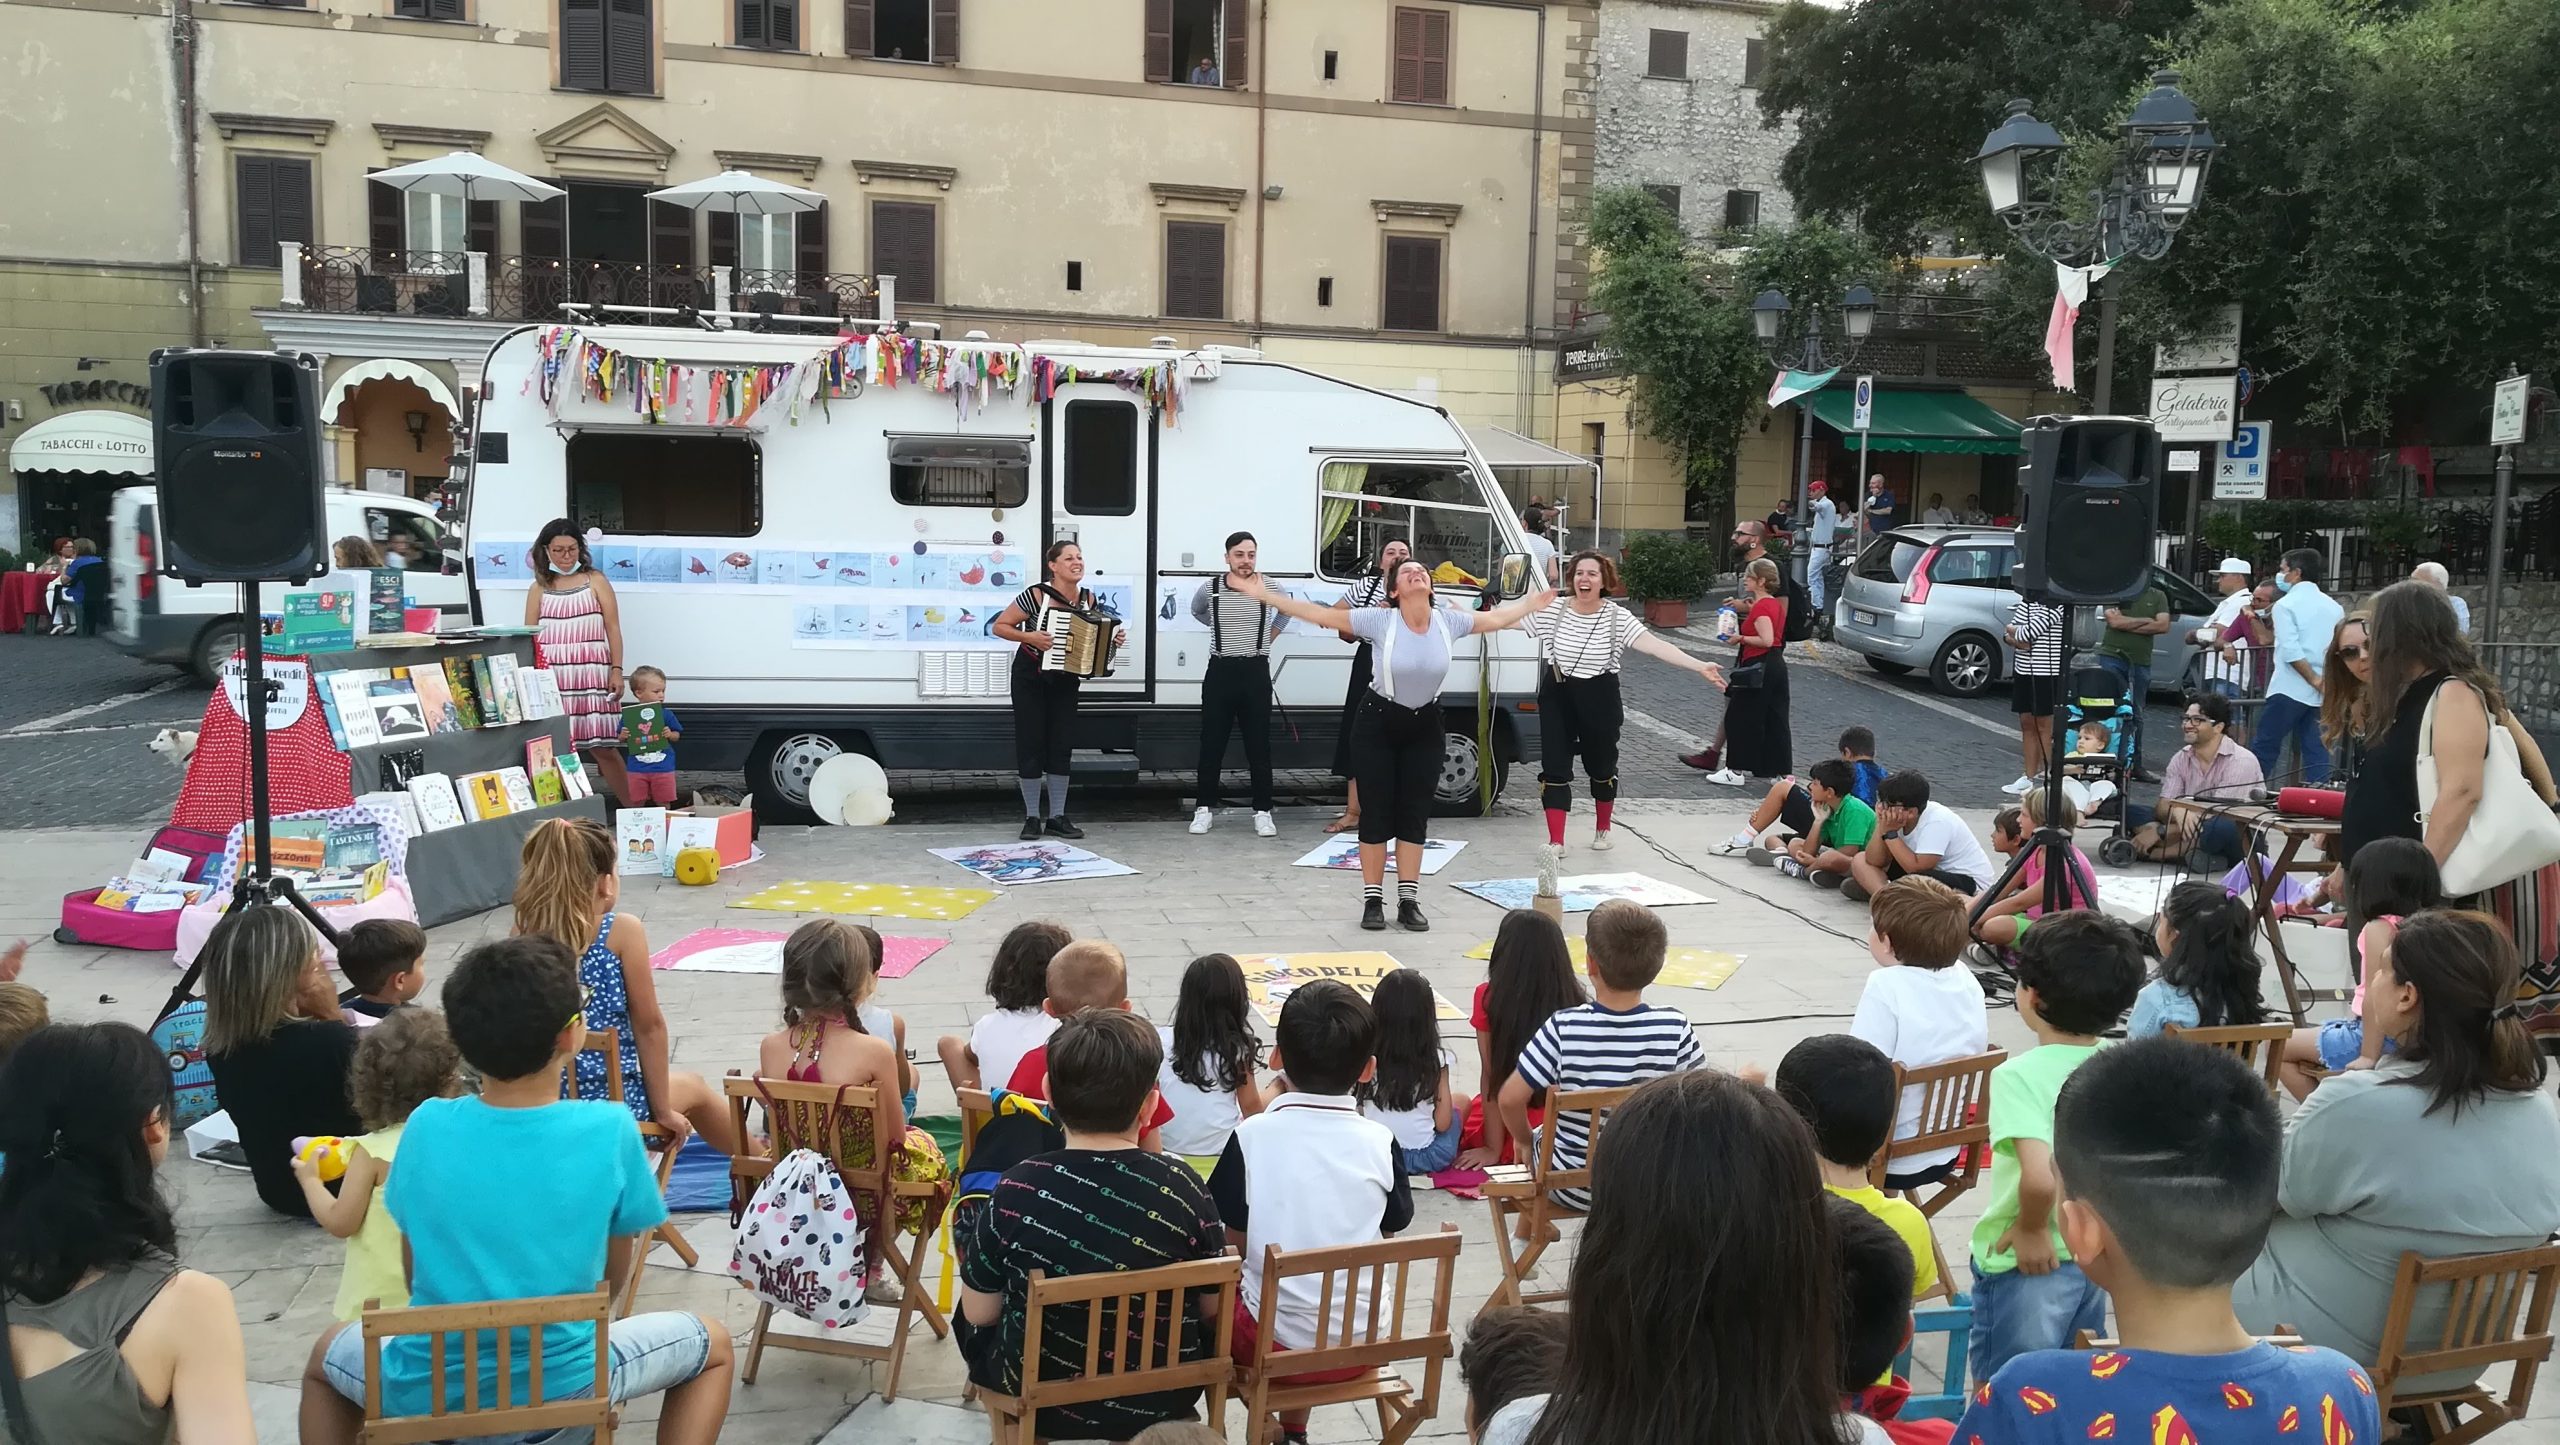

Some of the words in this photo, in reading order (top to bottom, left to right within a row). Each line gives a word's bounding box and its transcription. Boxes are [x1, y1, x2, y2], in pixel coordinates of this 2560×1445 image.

[2154, 387, 2229, 424] Gelateria
[2164, 415, 2211, 430] artigianale
[41, 439, 94, 450] TABACCHI
[106, 441, 147, 454] LOTTO
[2233, 430, 2254, 455] P
[171, 1016, 204, 1030] Tract
[1053, 1164, 1100, 1188] Champion
[1100, 1186, 1147, 1212] Champion
[1146, 1209, 1188, 1237] Champion
[1115, 1162, 1159, 1188] Champion
[1160, 1185, 1196, 1217] Champion
[1037, 1189, 1083, 1214] Champion
[1084, 1212, 1131, 1238] Champion
[1022, 1215, 1068, 1240] Champion
[1069, 1239, 1114, 1264] Champion
[755, 1259, 819, 1292] MINNIE
[760, 1277, 817, 1311] MOUSE
[1103, 1400, 1155, 1415] Champion
